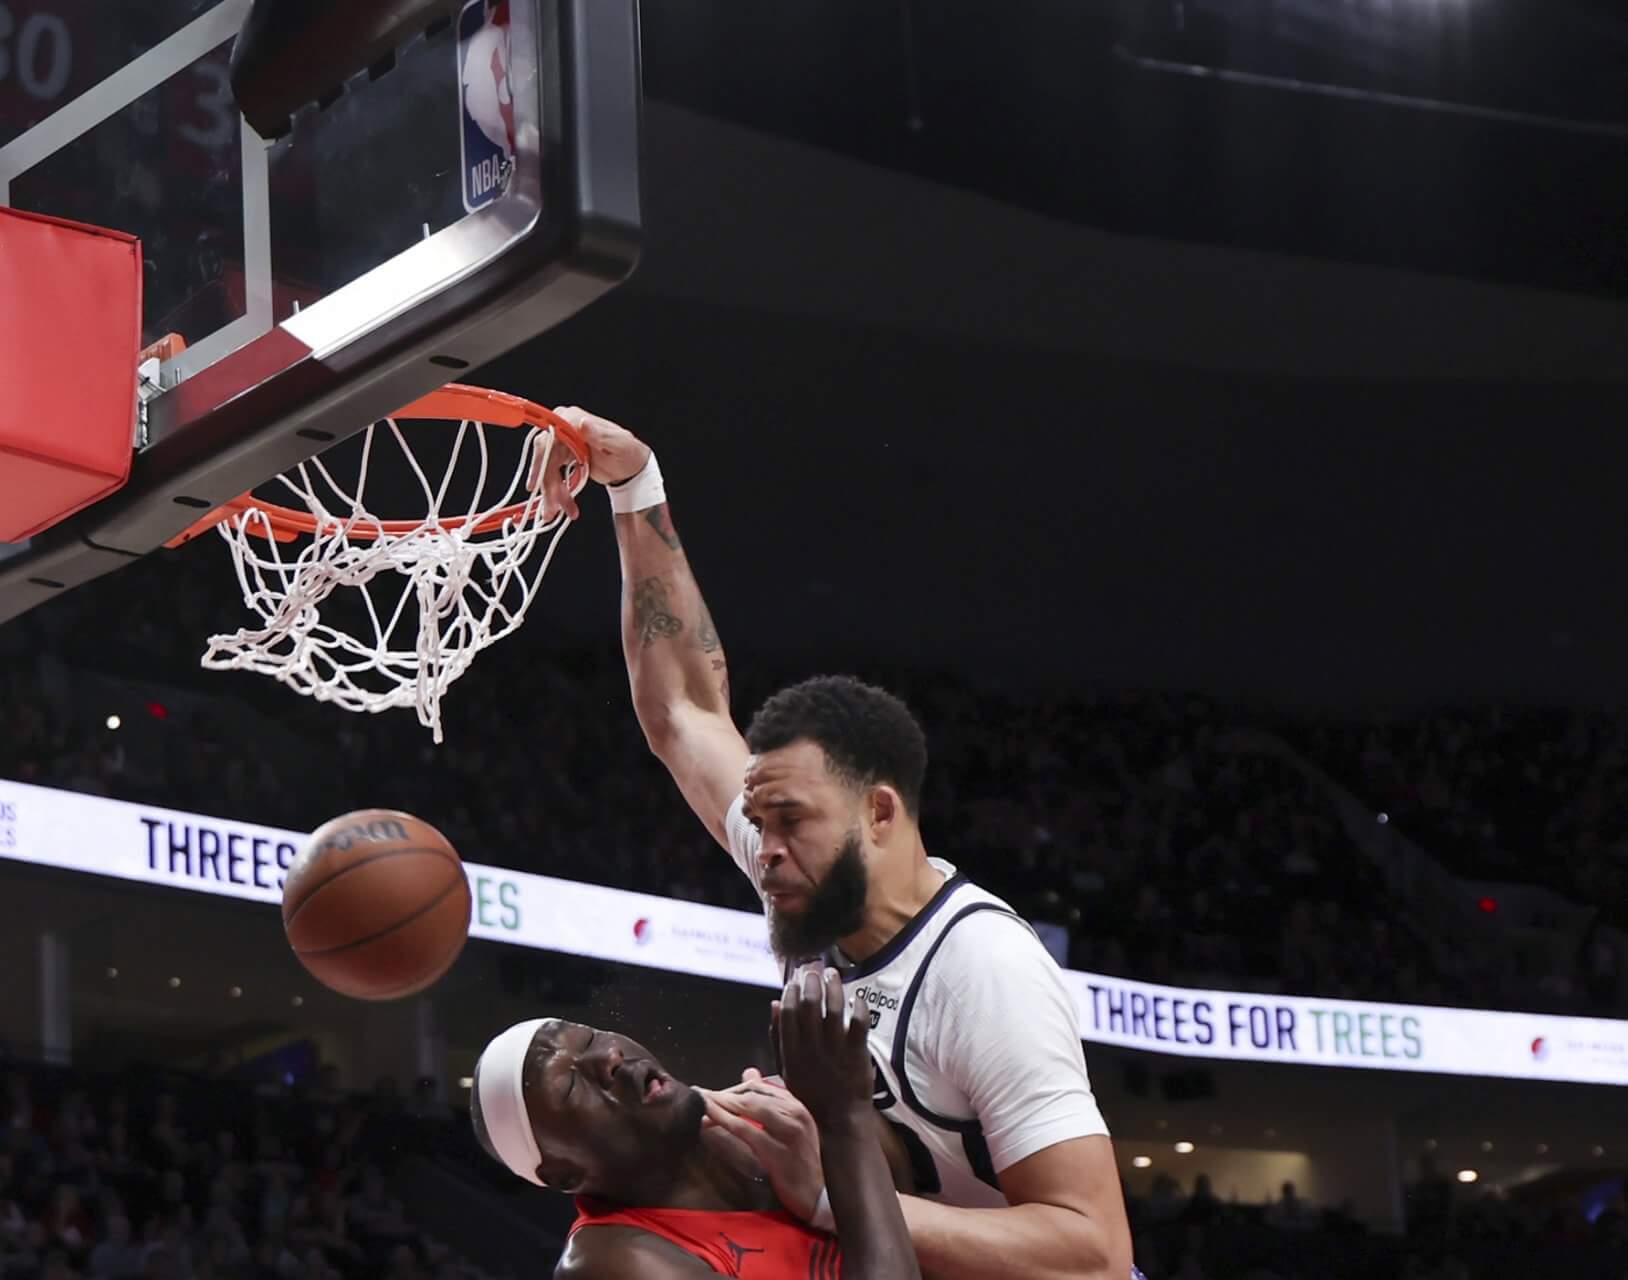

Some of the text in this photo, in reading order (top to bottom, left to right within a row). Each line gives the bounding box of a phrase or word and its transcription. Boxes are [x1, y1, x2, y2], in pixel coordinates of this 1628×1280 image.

[472, 154, 501, 199] NBA
[140, 817, 296, 890] THREES
[477, 877, 519, 930] ES
[1087, 985, 1423, 1059] THREES FOR TREES
